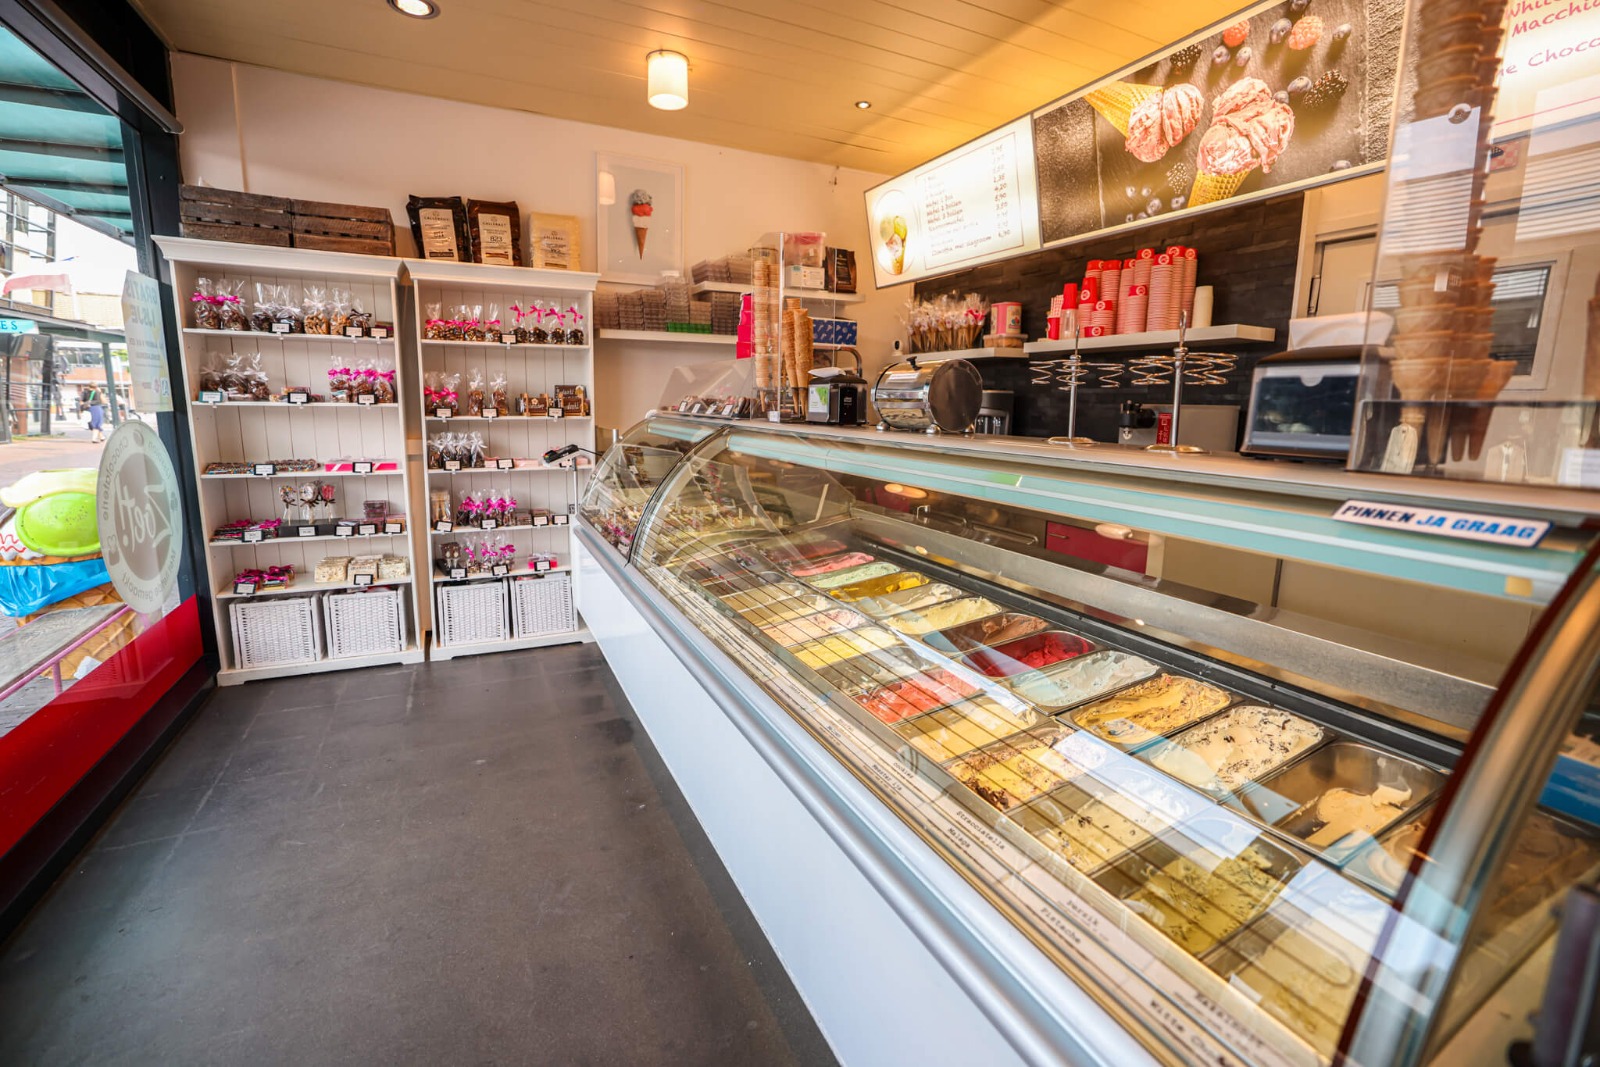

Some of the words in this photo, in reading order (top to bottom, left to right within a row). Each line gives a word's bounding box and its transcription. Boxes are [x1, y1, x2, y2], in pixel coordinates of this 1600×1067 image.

[1341, 505, 1415, 523] PINNEN
[1416, 515, 1448, 528] JA
[1451, 518, 1537, 540] GRAAG
[949, 828, 970, 848] Malaga
[956, 810, 1005, 850] Stracciatella
[1041, 907, 1081, 944] Pistache
